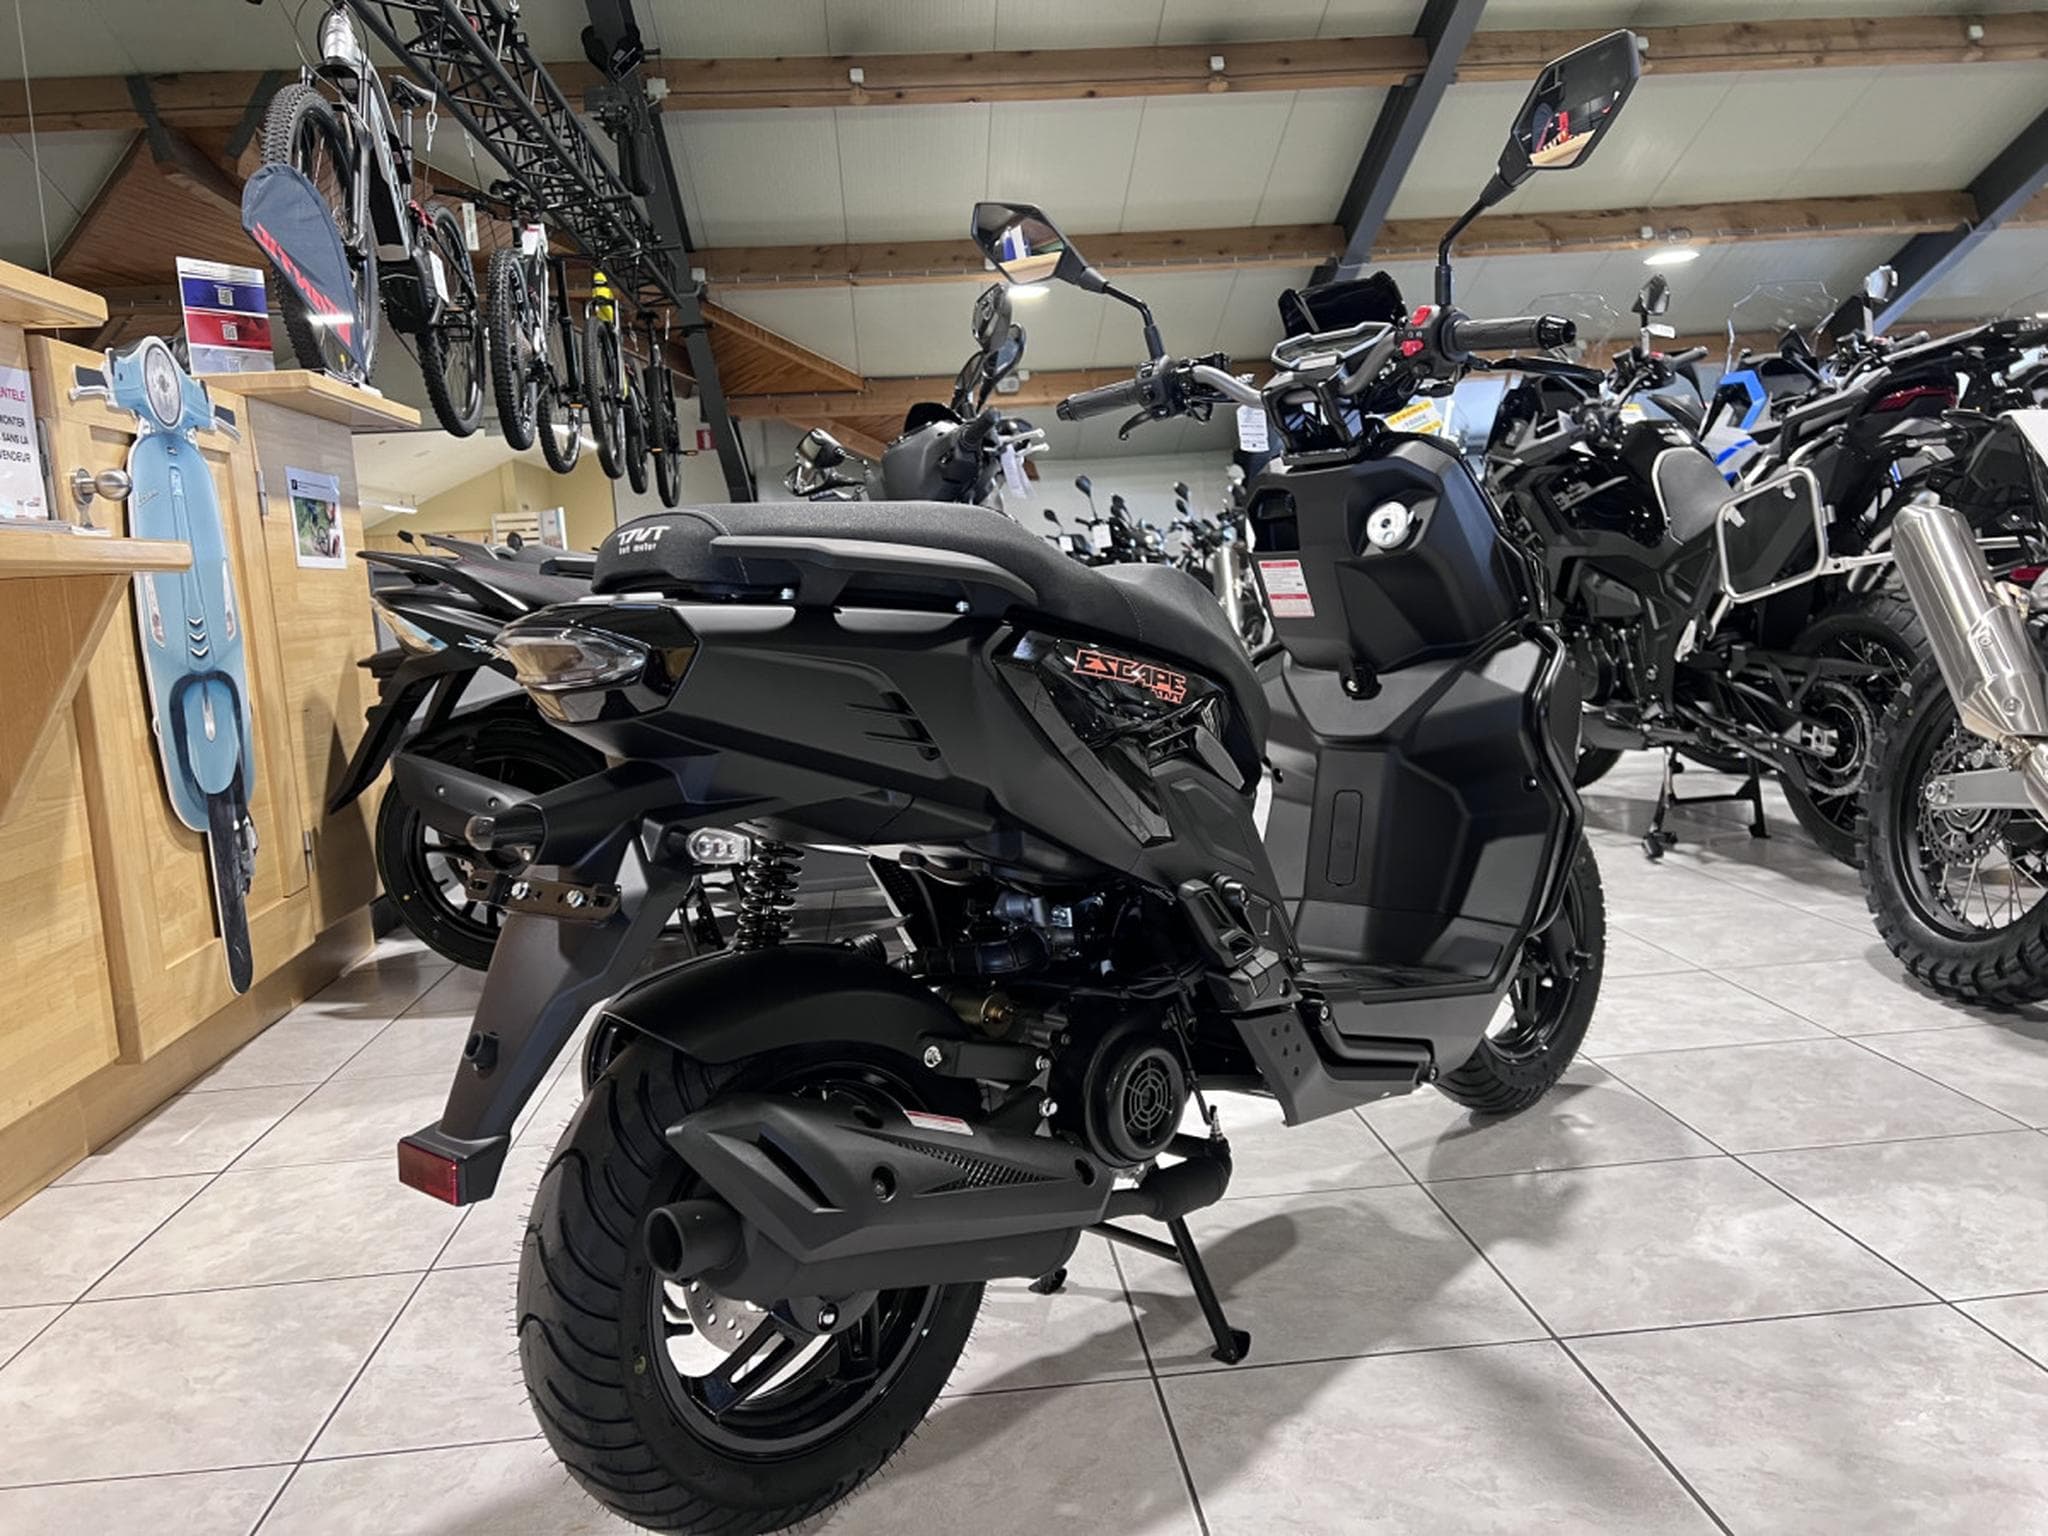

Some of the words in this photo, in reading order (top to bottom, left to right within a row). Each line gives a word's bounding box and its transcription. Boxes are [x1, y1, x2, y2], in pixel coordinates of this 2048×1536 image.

[0, 387, 26, 402] NTELE
[617, 525, 671, 546] TNT
[1073, 648, 1187, 696] ESCAPE
